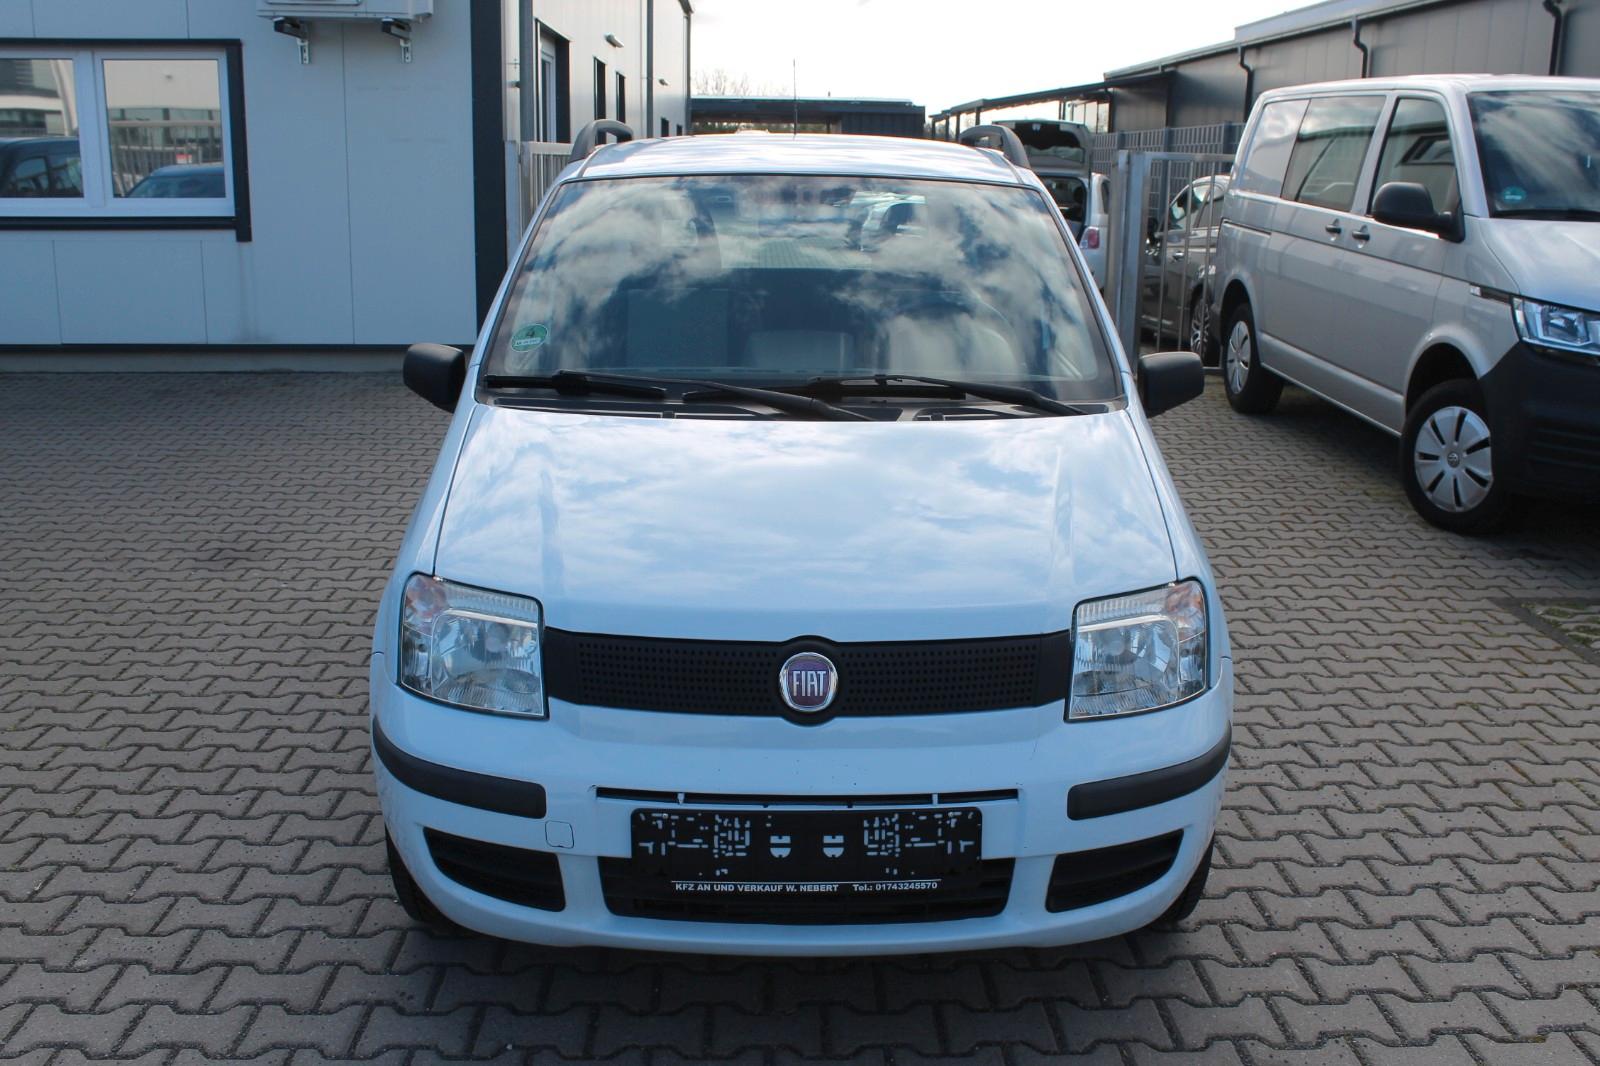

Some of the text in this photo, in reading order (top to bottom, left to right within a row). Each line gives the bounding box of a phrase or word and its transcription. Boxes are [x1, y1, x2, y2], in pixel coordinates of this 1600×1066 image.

[793, 670, 826, 696] FIAT
[675, 883, 695, 891] KFZ
[697, 883, 711, 891] AN
[713, 884, 735, 892] UND
[737, 884, 783, 892] VERKAUF
[852, 883, 873, 891] Tel.:
[875, 882, 938, 891] 01743245570
